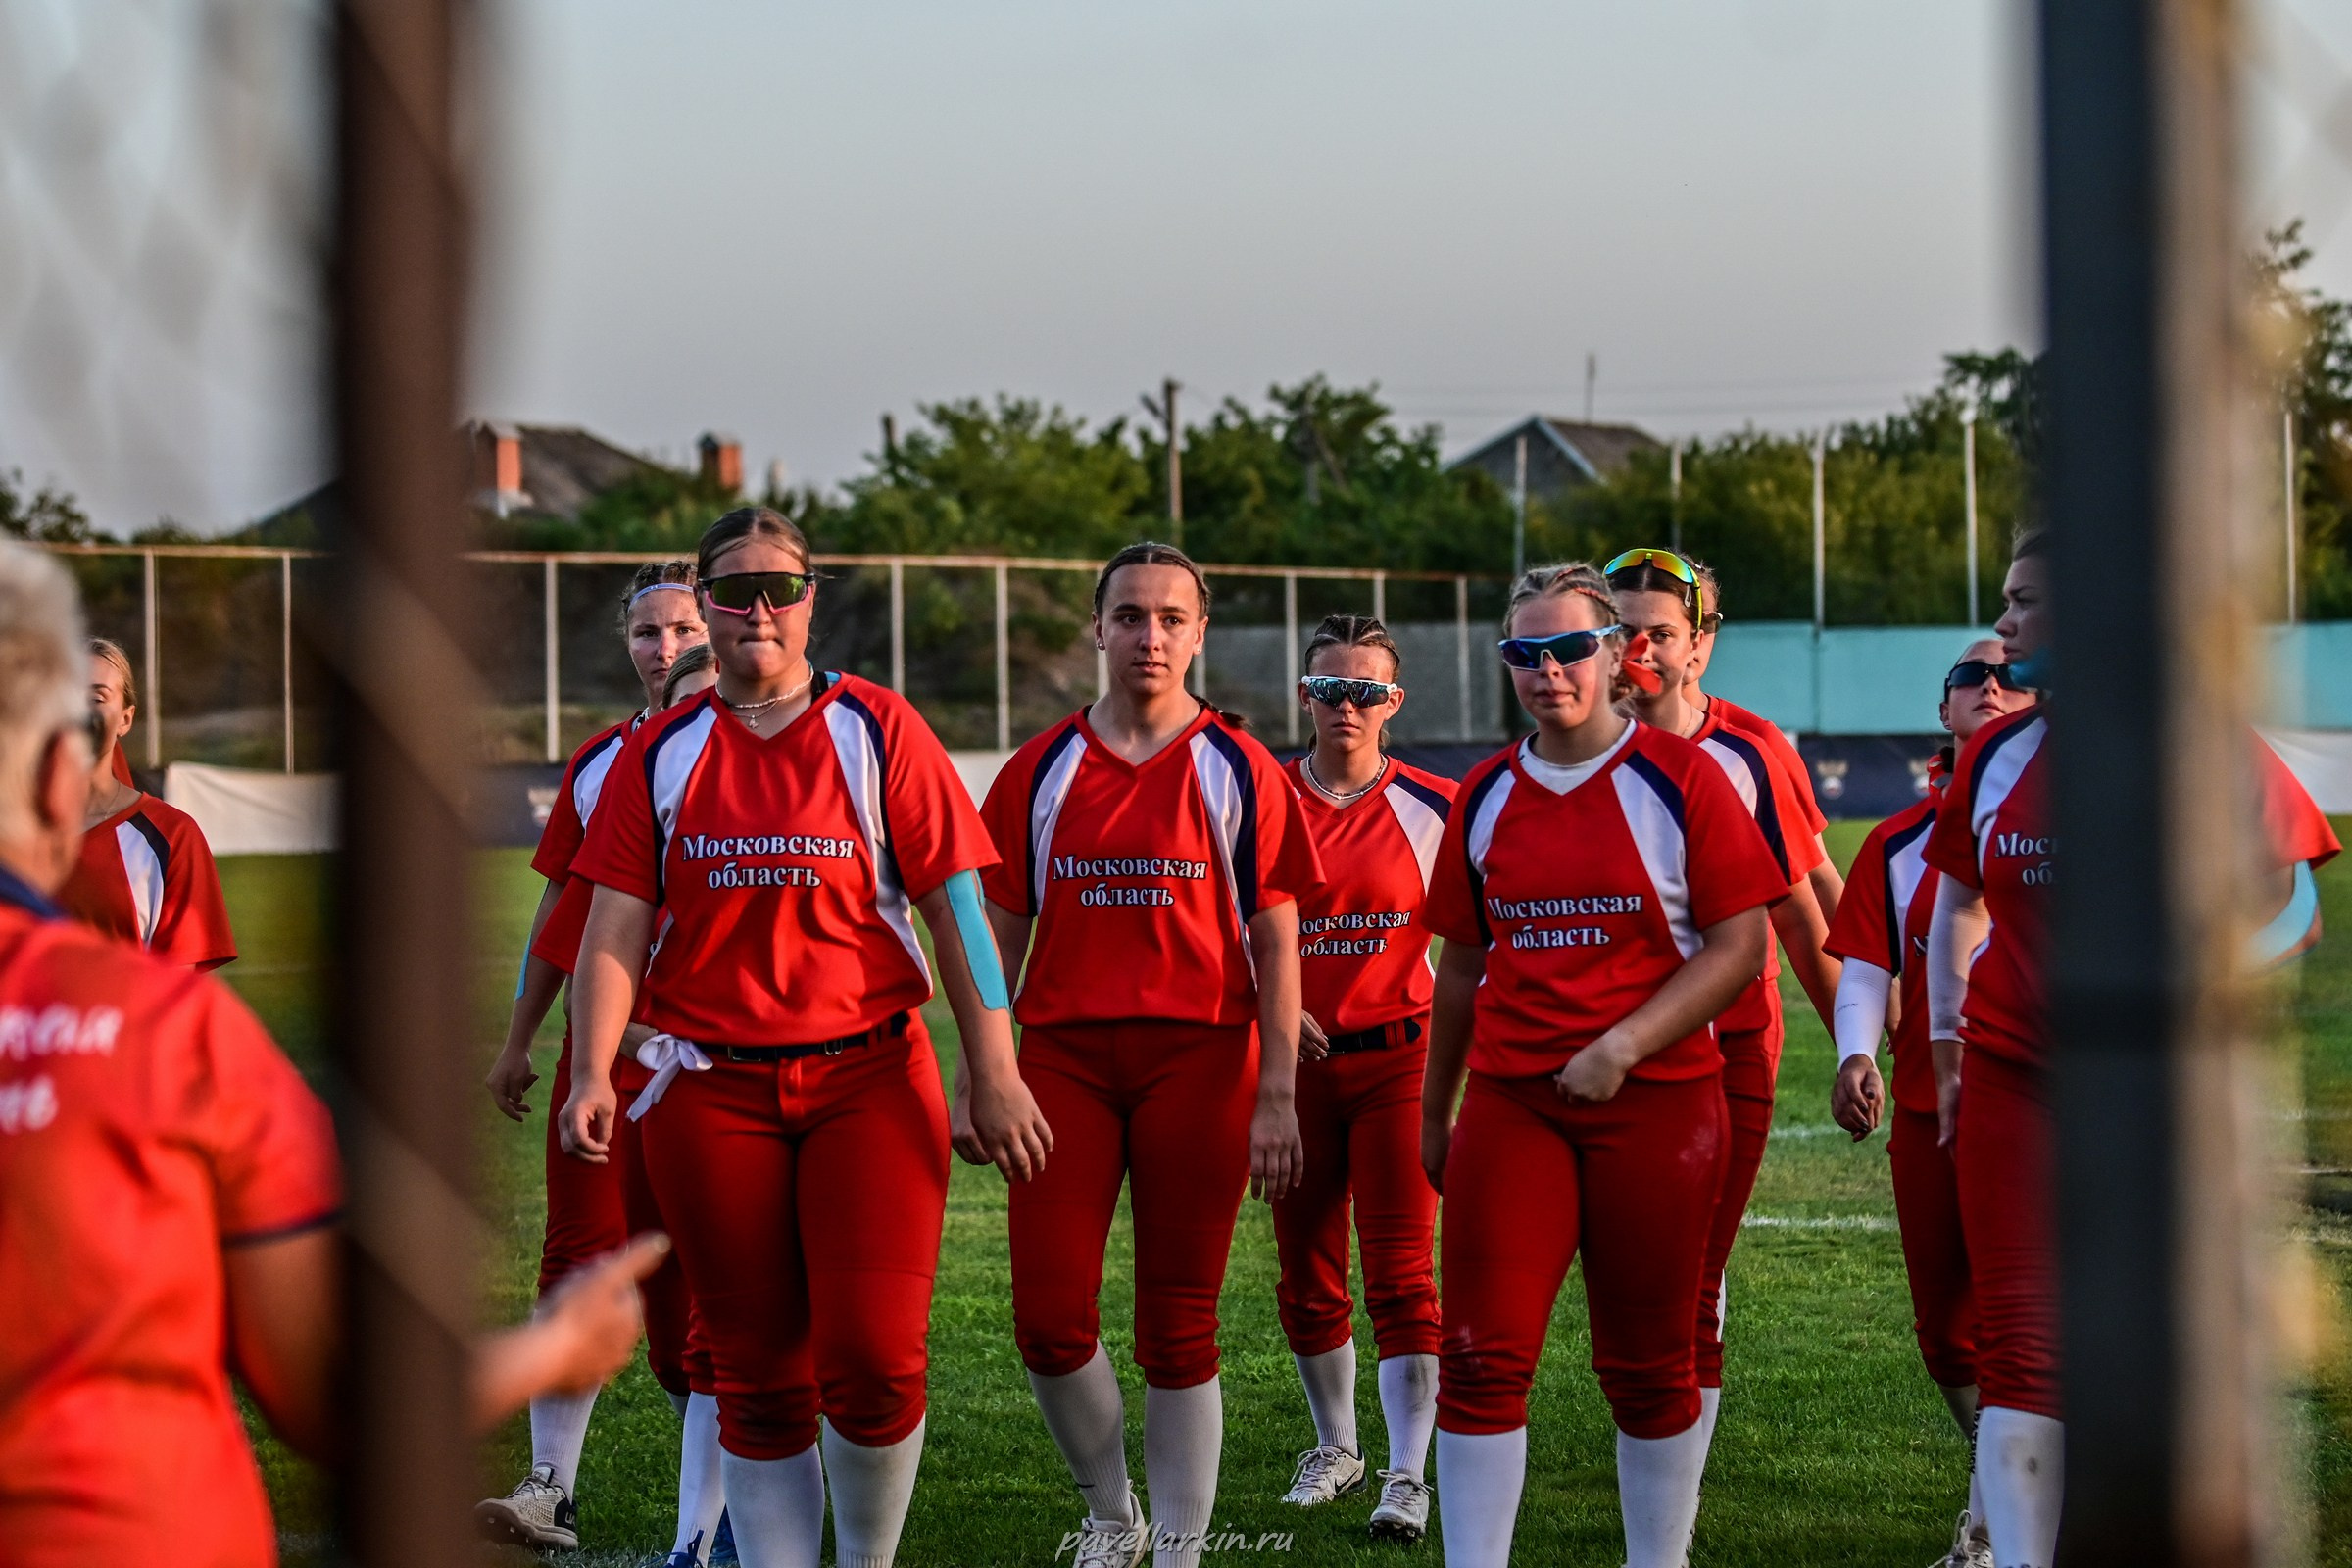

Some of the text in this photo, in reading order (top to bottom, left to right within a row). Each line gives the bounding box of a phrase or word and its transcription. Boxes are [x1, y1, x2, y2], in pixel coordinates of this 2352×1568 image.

[682, 834, 856, 861] Московская
[1994, 832, 2058, 858] Мос
[707, 861, 821, 889] область
[1053, 855, 1207, 880] Московская
[1080, 883, 1174, 906] область
[1487, 895, 1642, 920] Московская
[1300, 936, 1388, 957] область
[1512, 924, 1610, 949] область
